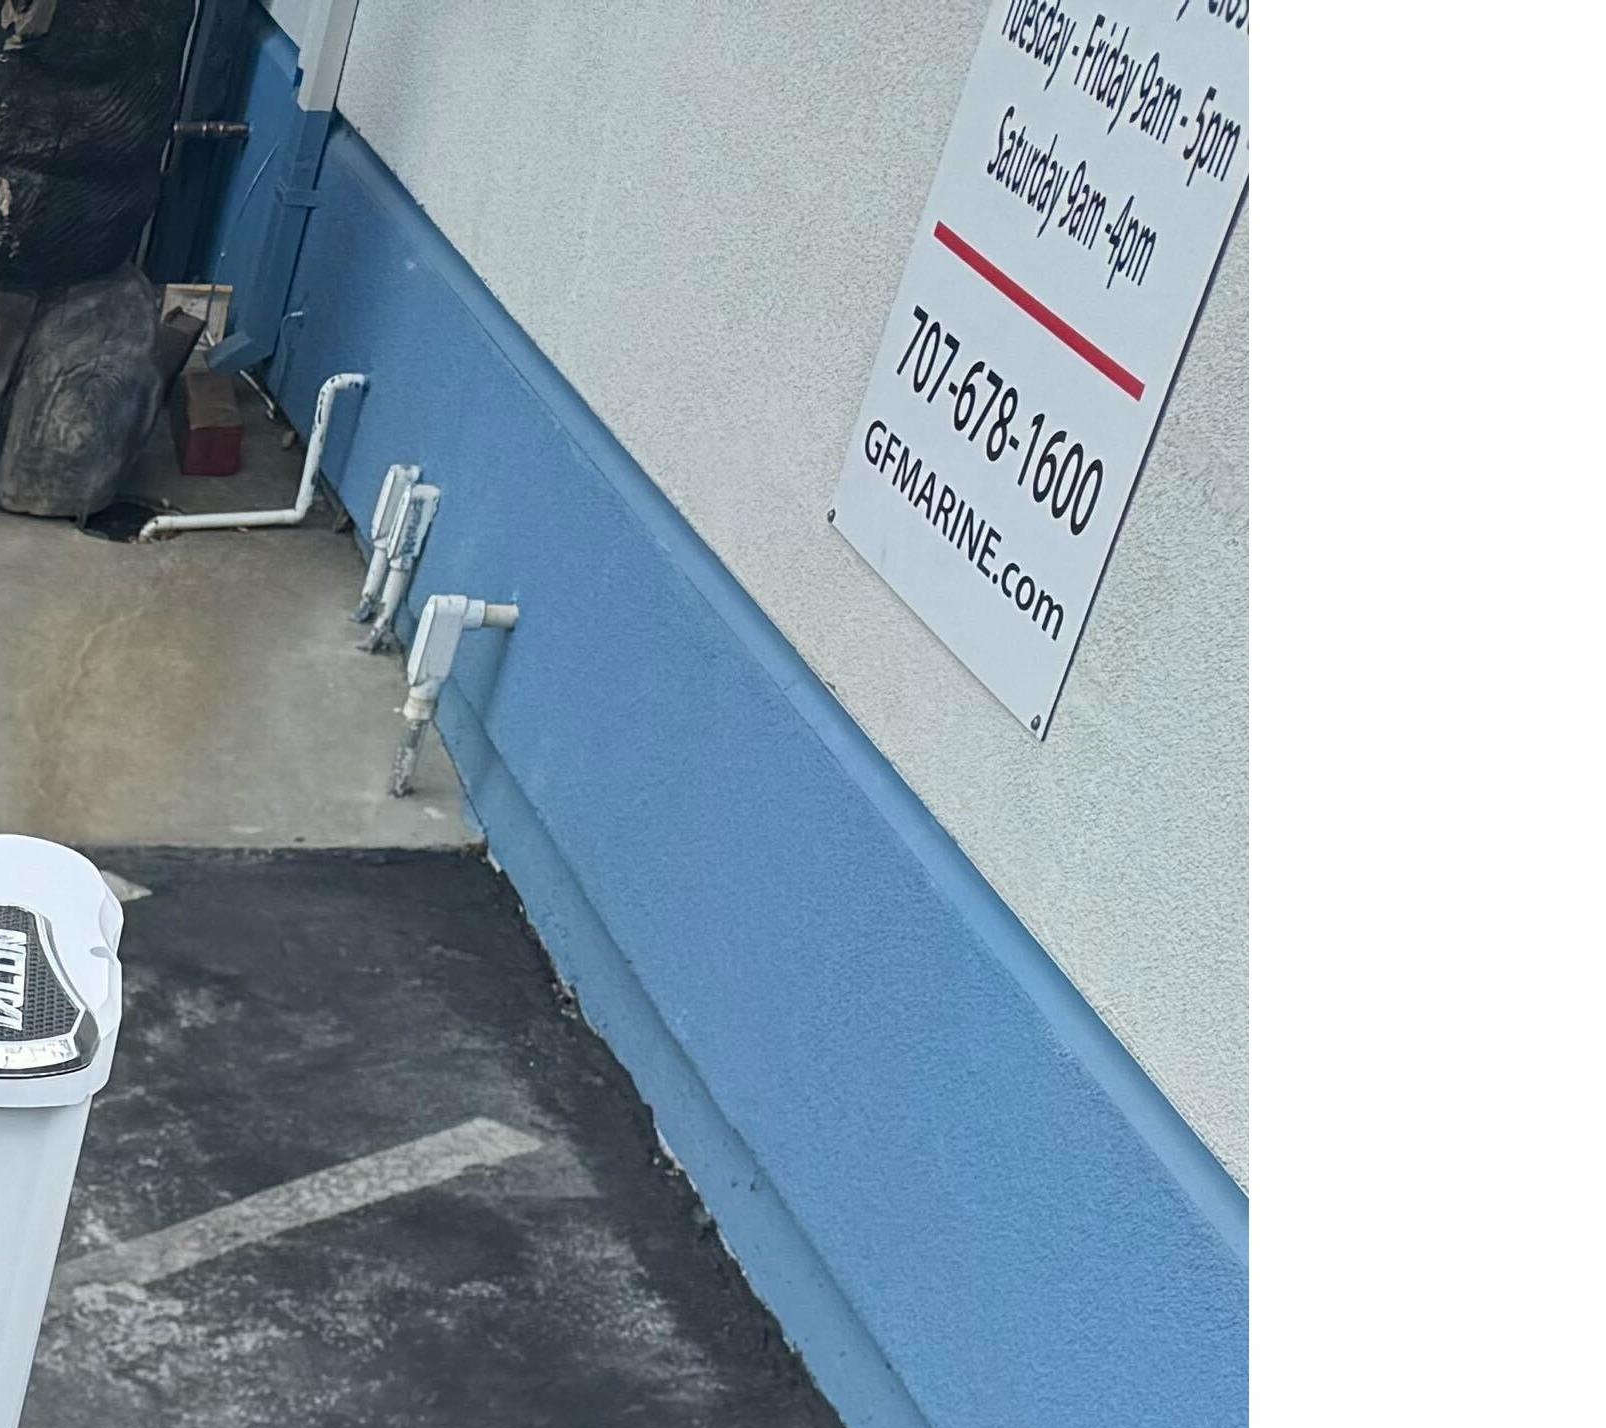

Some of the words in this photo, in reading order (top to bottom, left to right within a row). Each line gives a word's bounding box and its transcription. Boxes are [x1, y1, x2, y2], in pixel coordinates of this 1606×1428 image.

[987, 106, 1069, 238] Saturday
[1058, 160, 1107, 250] 9am
[1074, 14, 1142, 135] Friday
[1129, 52, 1182, 144] 9am
[1183, 86, 1241, 187] 5pm
[896, 305, 1104, 536] 707-678-1600
[864, 420, 1065, 642] GFMARINE.com
